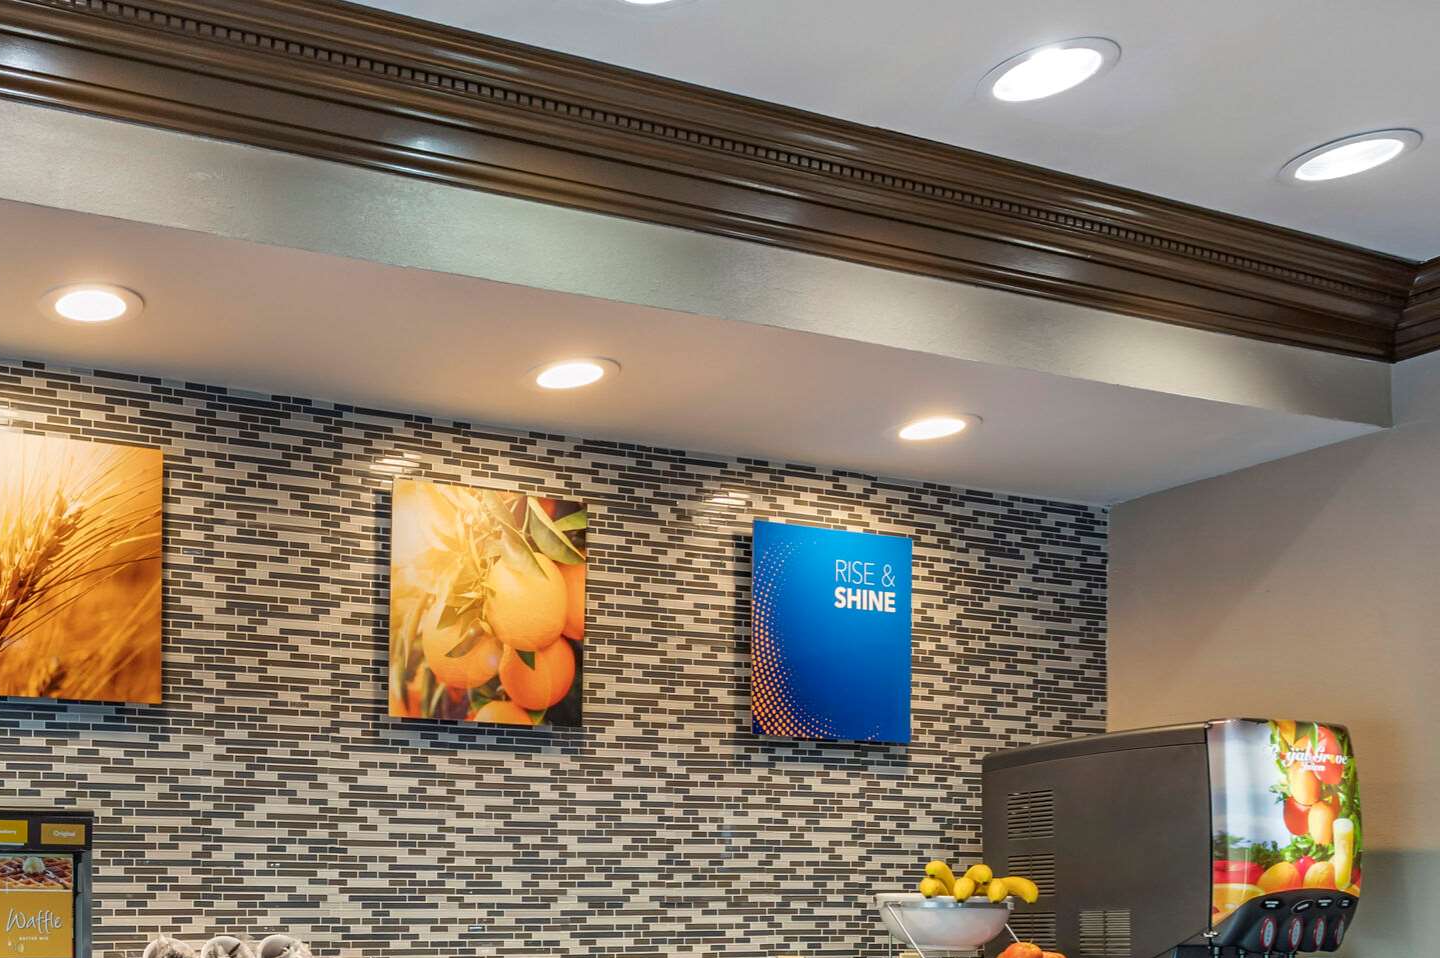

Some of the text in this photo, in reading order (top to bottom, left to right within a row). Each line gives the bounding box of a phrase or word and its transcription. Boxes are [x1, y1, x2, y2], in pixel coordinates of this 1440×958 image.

[835, 559, 896, 588] RISE &
[834, 586, 897, 613] SHINE
[6, 908, 62, 934] Waffle
